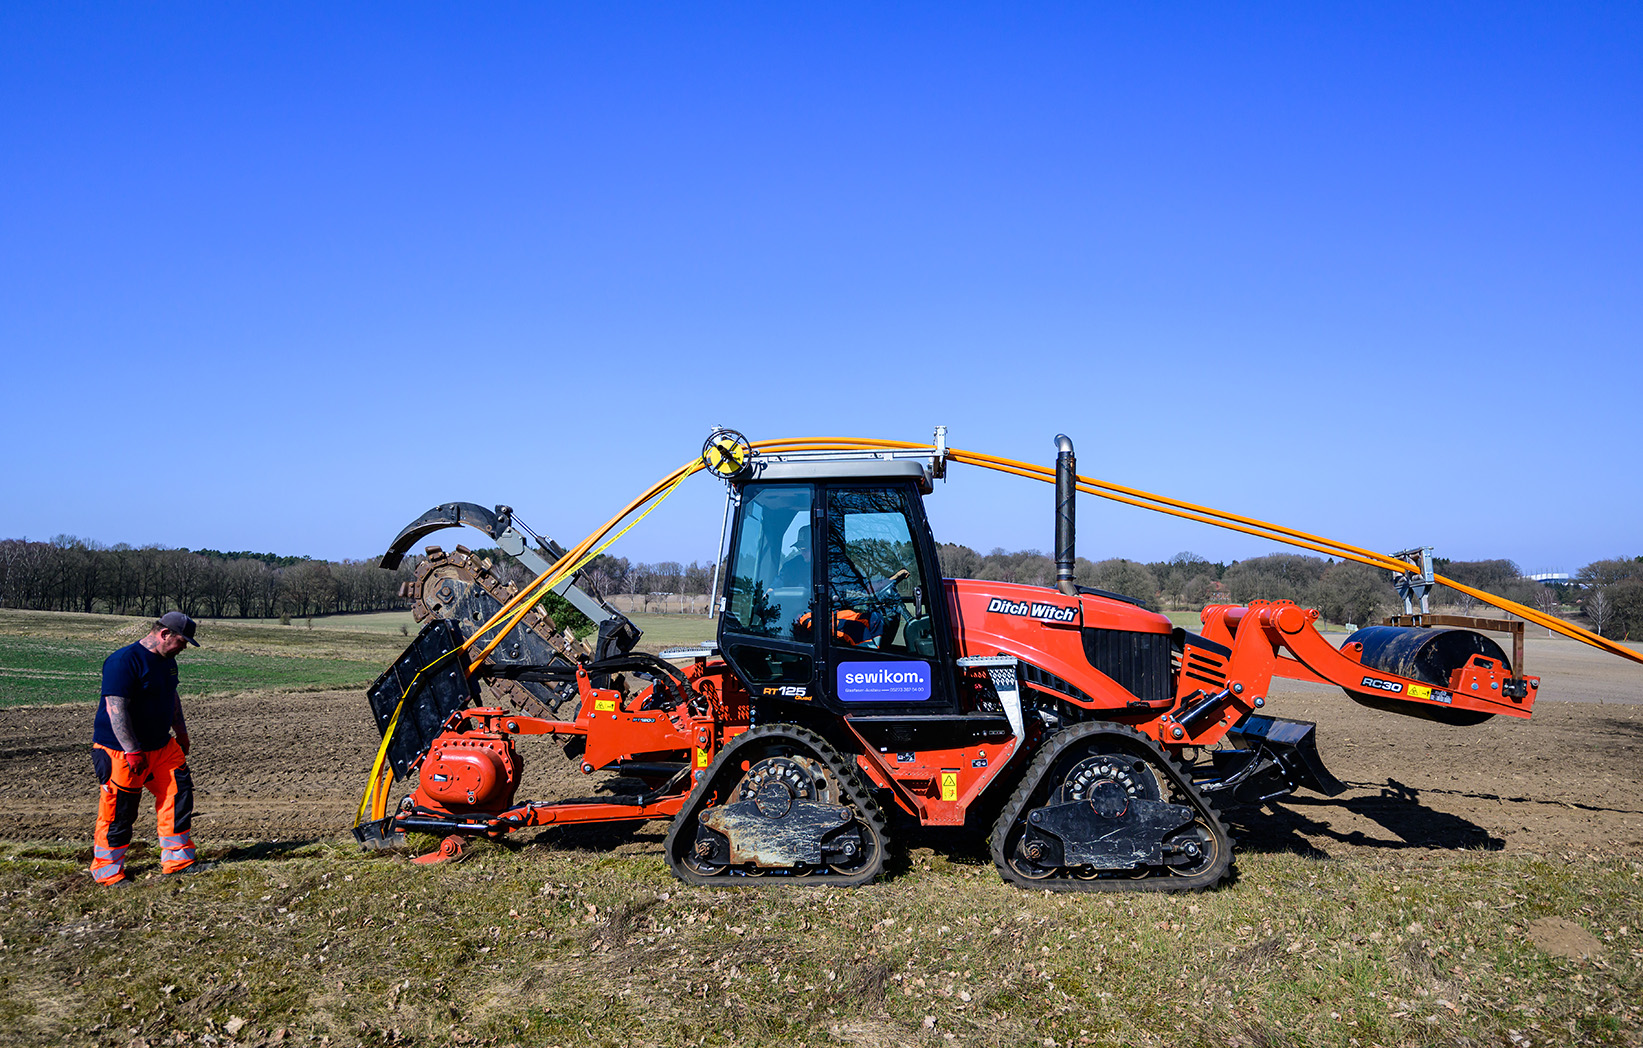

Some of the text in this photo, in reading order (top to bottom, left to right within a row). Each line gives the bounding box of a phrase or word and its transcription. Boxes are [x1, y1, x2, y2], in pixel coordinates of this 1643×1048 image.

[988, 599, 1029, 616] Ditch
[845, 669, 924, 684] sewikom.
[1362, 677, 1403, 692] RC30
